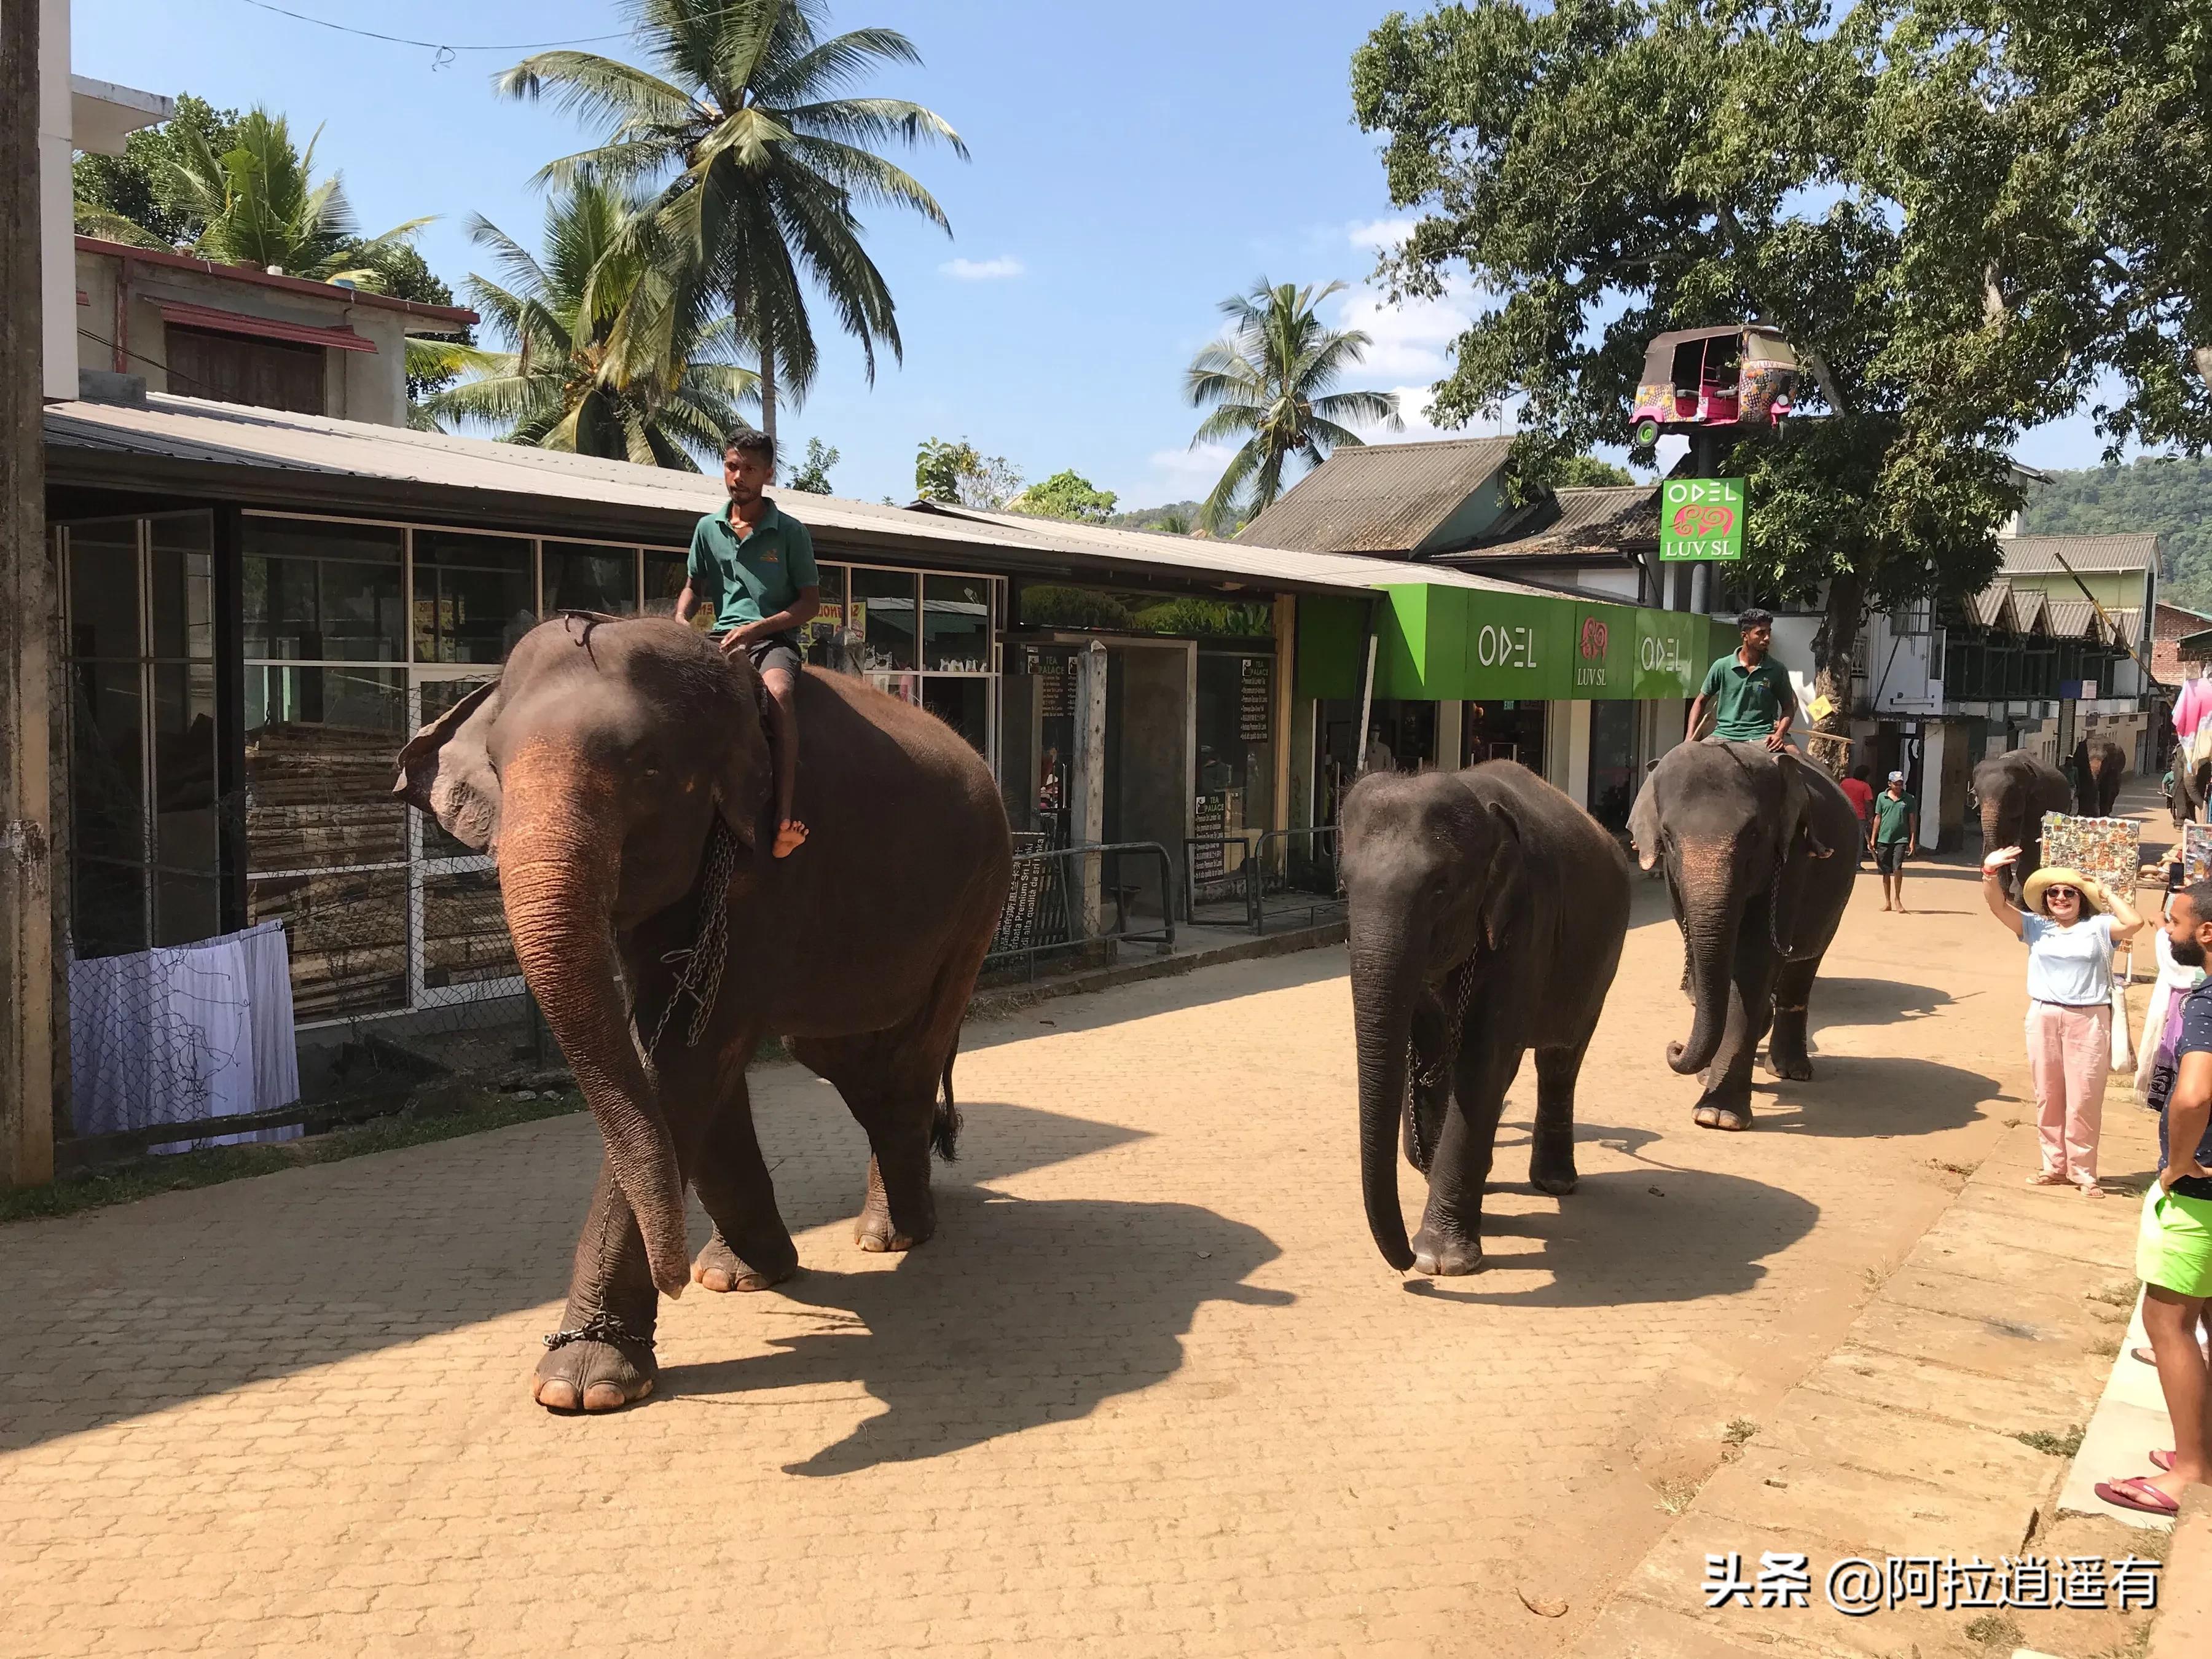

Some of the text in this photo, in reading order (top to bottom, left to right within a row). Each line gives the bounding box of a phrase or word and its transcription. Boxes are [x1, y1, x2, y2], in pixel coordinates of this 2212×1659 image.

[1668, 482, 1737, 503] ODEL
[1666, 541, 1735, 556] LUV SL
[1478, 625, 1537, 668] ODEL
[1046, 656, 1057, 664] TEA
[1641, 637, 1682, 672] ODEL
[1039, 666, 1064, 675] PALACE
[1577, 668, 1606, 686] LUV SL
[1504, 700, 1515, 710] EXIT
[1205, 803, 1225, 812] PALACE
[1033, 838, 1045, 861] lnka
[1032, 863, 1040, 874] sri
[1030, 877, 1038, 887] da
[1011, 842, 1034, 950] erbata Premium Sri Lnki
[1027, 889, 1037, 918] qualità
[1023, 920, 1032, 935] alta
